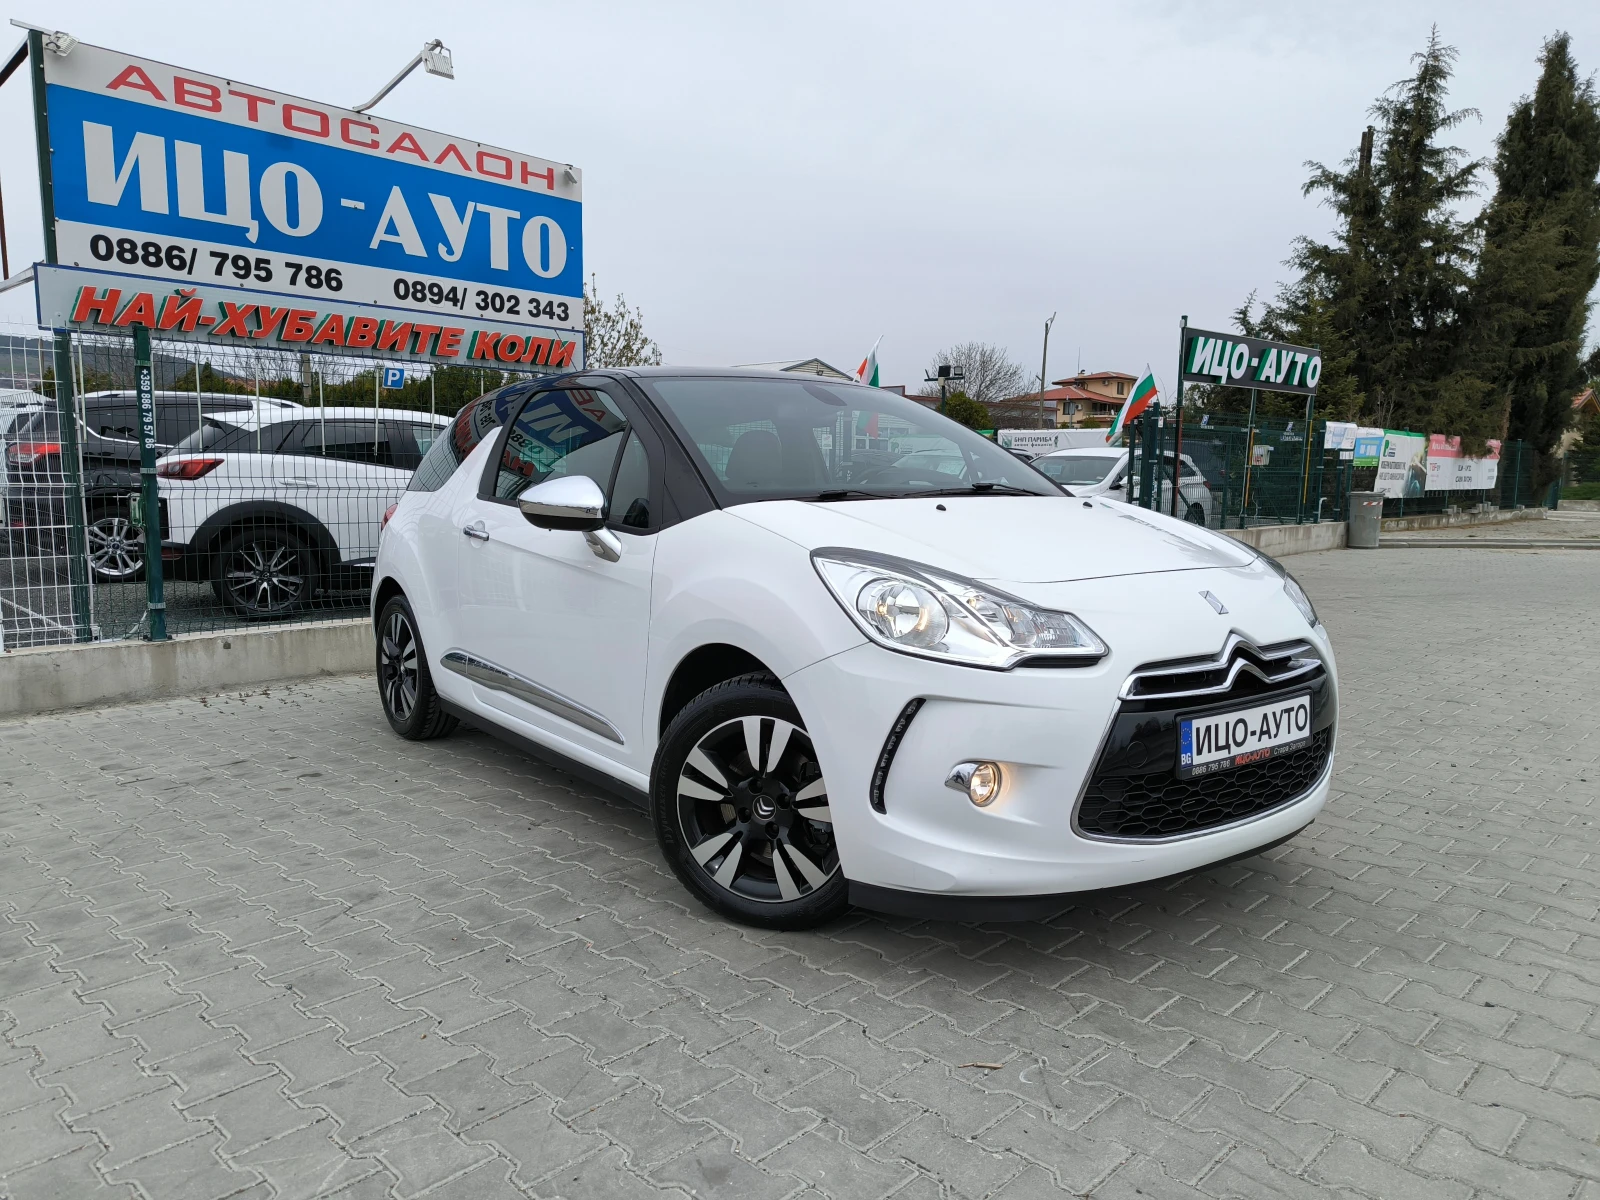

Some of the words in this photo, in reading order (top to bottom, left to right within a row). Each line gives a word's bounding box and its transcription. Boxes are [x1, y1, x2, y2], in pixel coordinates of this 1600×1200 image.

[106, 65, 554, 190] АВТОСАЛОН
[89, 234, 197, 275] 0886/
[209, 251, 273, 282] 795
[284, 262, 343, 292] 786
[393, 278, 467, 310] 0894/
[475, 290, 520, 315] 302
[528, 300, 569, 322] 343
[70, 285, 465, 357] НАЙ-ХУБАВИТЕ
[470, 330, 576, 367] КОЛИ
[1189, 336, 1322, 388] ИЦО-АУТО
[141, 369, 151, 391] +359
[387, 370, 400, 386] P
[141, 393, 152, 410] 886
[143, 412, 153, 423] 79
[144, 425, 154, 436] 57
[145, 438, 155, 449] 86
[1195, 703, 1309, 756] ИЦО-АУТО
[1181, 752, 1192, 766] BG
[1208, 762, 1219, 771] 795
[1219, 759, 1231, 768] 786
[1234, 748, 1271, 766] ИЦО-АУТО
